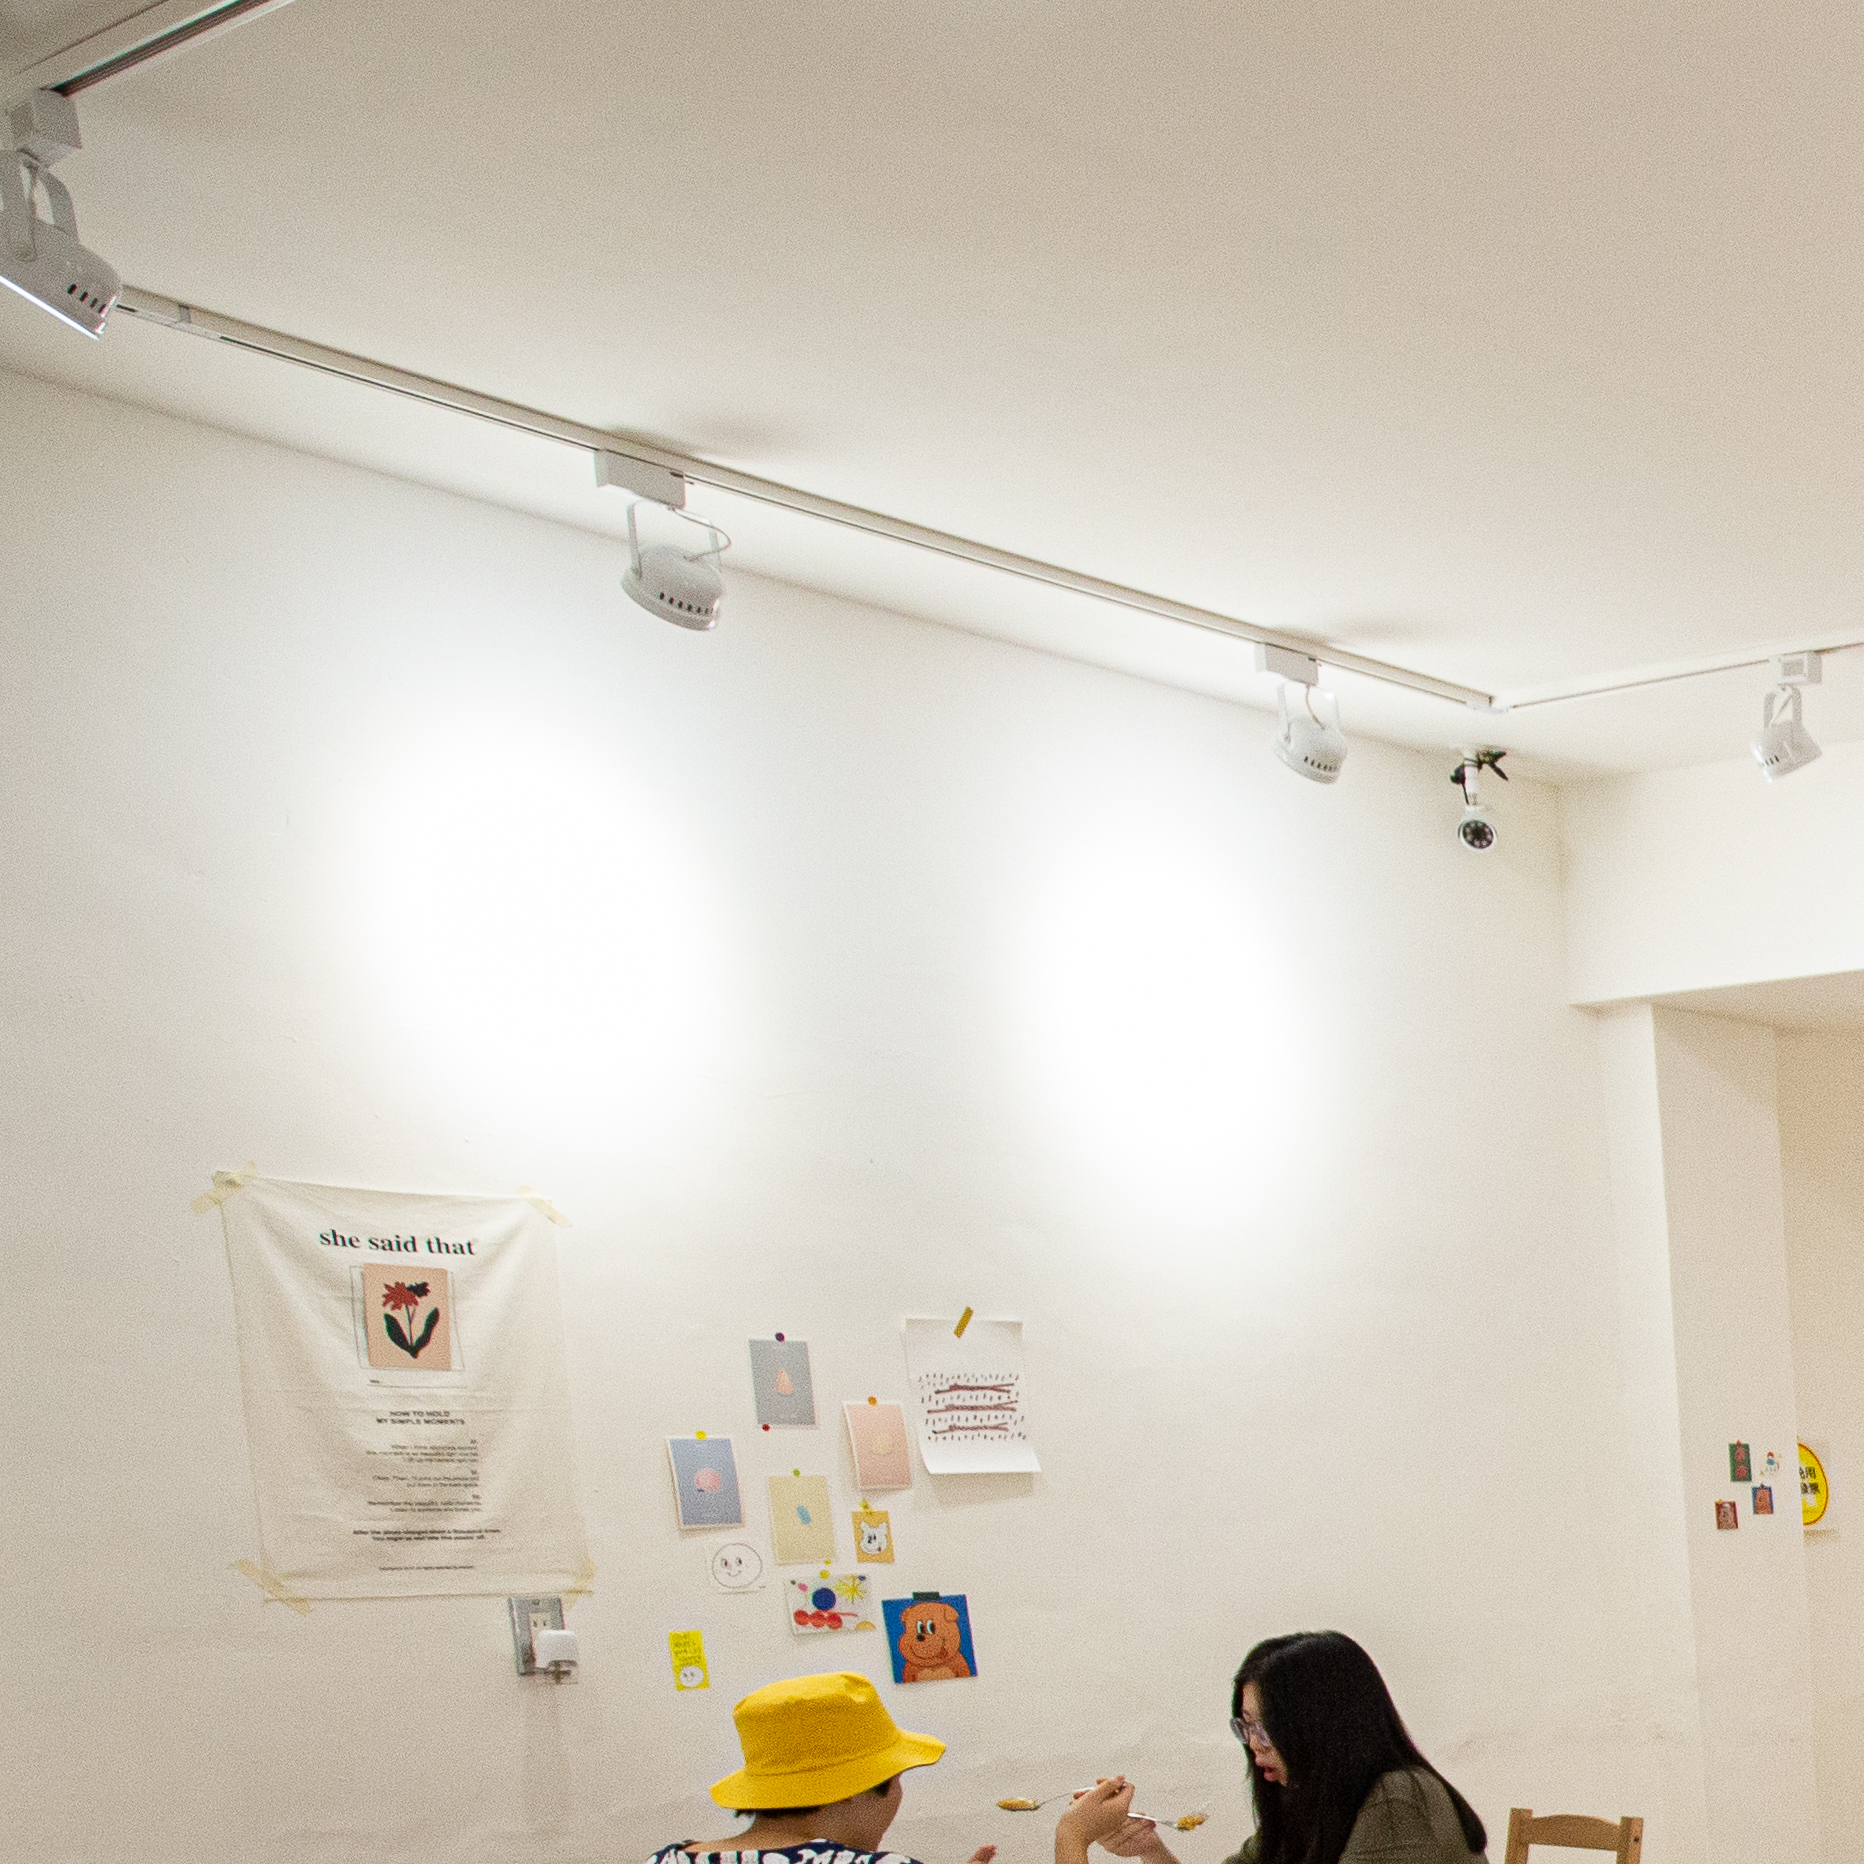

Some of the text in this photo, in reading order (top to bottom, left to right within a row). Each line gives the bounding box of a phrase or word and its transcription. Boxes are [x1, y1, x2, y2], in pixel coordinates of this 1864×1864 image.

[319, 1229, 475, 1255] she said that
